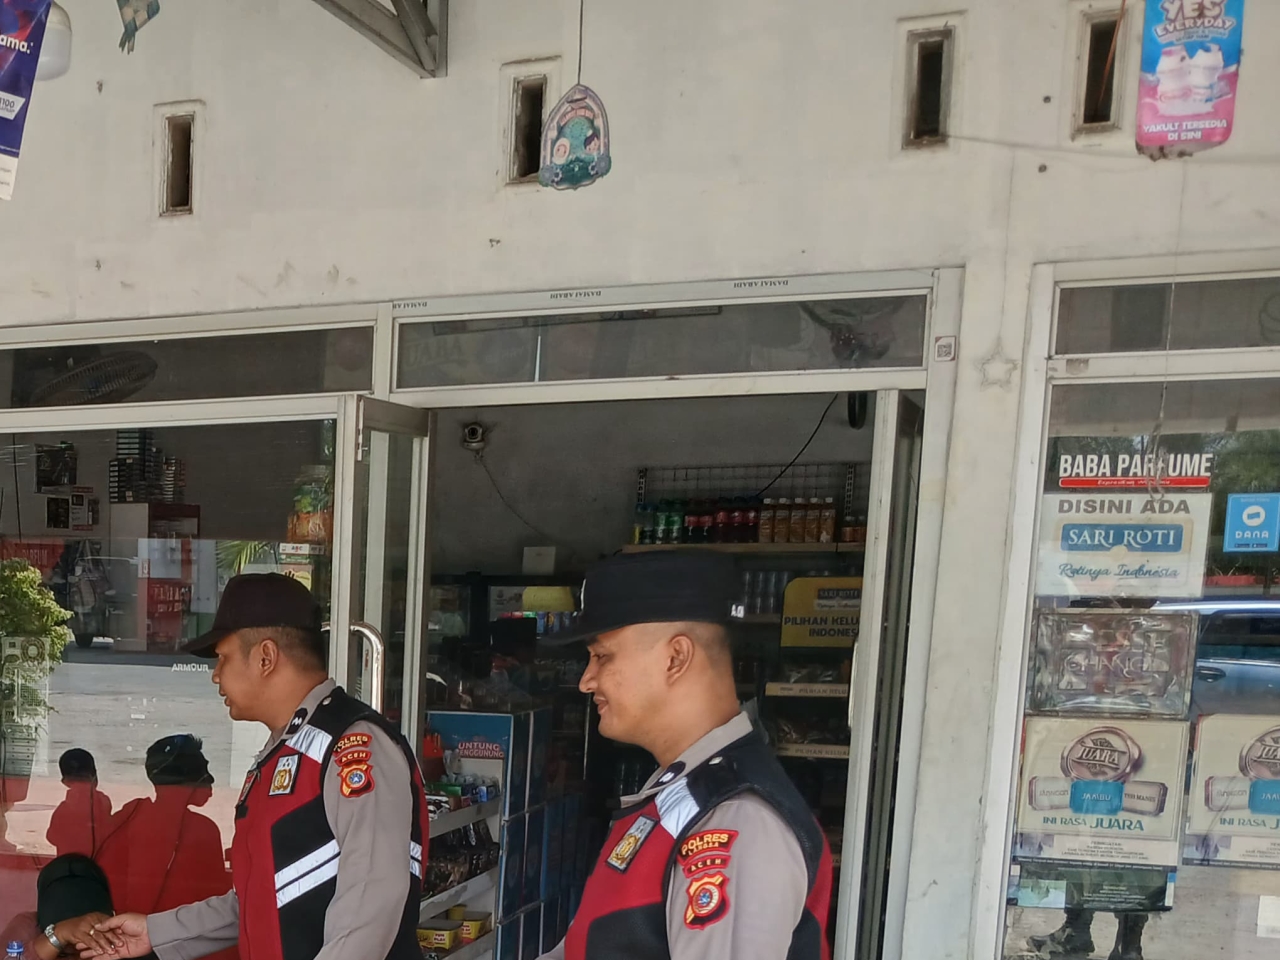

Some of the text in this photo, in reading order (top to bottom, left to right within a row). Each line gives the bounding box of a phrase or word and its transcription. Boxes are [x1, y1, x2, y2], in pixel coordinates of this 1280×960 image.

[1161, 0, 1224, 20] YES
[1155, 18, 1234, 37] EVERYDAY
[1144, 119, 1227, 133] YAKULT TERSEDIA
[1168, 132, 1202, 141] DI SINI
[1060, 454, 1111, 477] BABA
[1058, 499, 1190, 514] DISINI ADA
[1068, 529, 1175, 548] SARI ROTI
[1235, 530, 1269, 539] DANA
[1059, 563, 1180, 581] Rotinya Indonesia
[784, 616, 859, 625] PILIHAN KELU
[171, 663, 209, 672] ARMOUR
[458, 742, 500, 751] UNTUNG
[342, 752, 366, 762] ACEH
[459, 749, 504, 758] ENGGUNUNG
[1077, 746, 1118, 765] JUARA
[1081, 793, 1112, 801] JAMBU
[1060, 818, 1087, 826] RASA
[1090, 818, 1144, 831] JUARA
[1238, 818, 1266, 827] RASA
[681, 834, 728, 855] POLRES
[691, 858, 721, 872] ACEH
